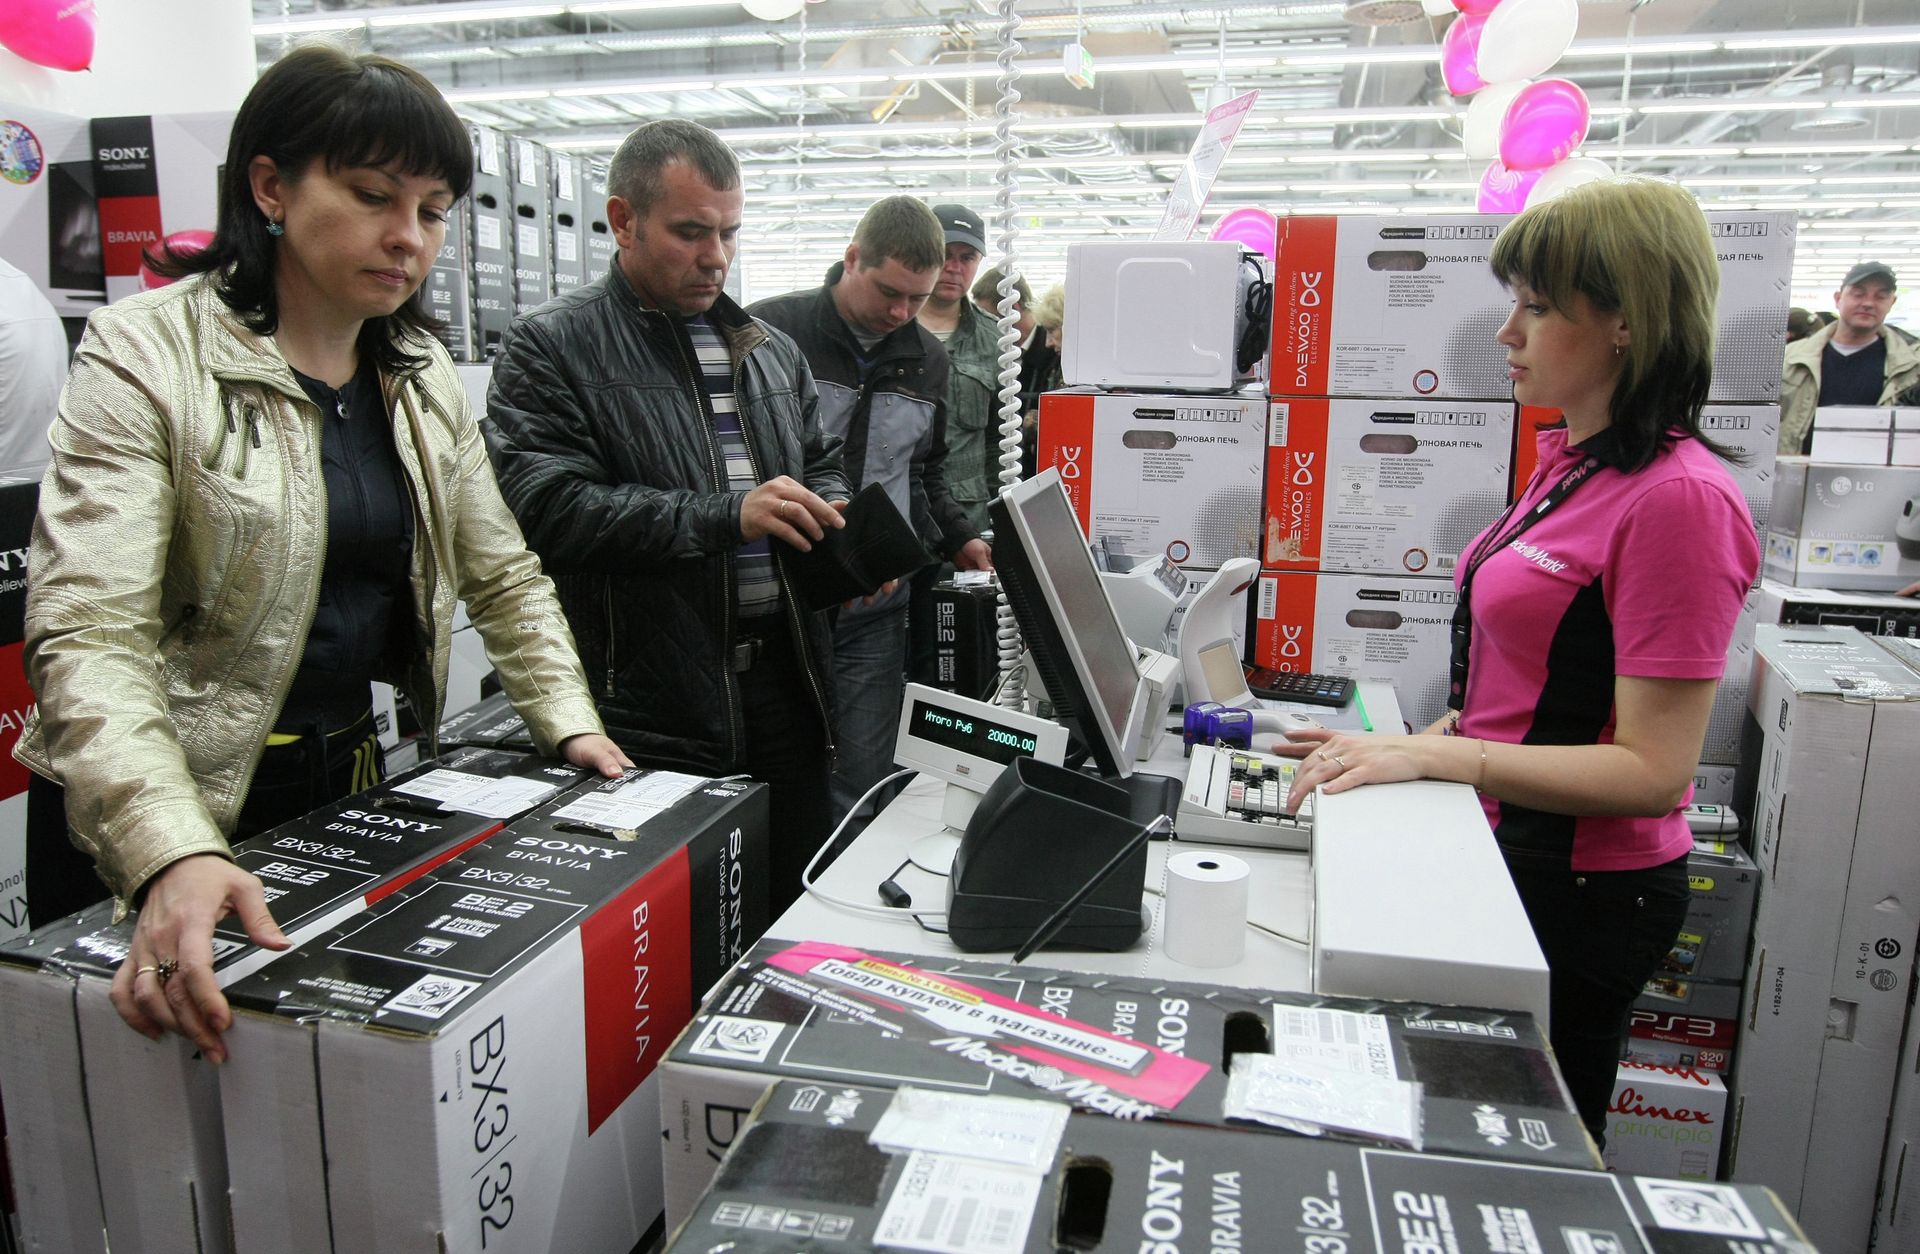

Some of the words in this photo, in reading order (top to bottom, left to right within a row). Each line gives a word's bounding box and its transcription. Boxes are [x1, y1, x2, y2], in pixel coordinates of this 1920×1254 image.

[99, 146, 149, 161] SONY
[107, 230, 157, 243] BRAVIA
[589, 238, 612, 250] SONY
[475, 262, 504, 275] SONY
[1738, 253, 1764, 262] ПЕЧЬ
[516, 268, 542, 281] SONY
[555, 273, 578, 285] SONY
[1286, 308, 1297, 353] Designing
[1310, 312, 1319, 364] ELECTRONICS
[1296, 312, 1311, 387] DAEWOO
[1217, 436, 1239, 444] ПЕЧЬ
[1460, 440, 1482, 448] ПЕЧЬ
[1724, 443, 1746, 454] ЕЧЬ
[1282, 450, 1290, 490] Excellence
[1856, 481, 1874, 492] LG
[1280, 490, 1290, 530] Designing
[1303, 491, 1312, 541] ELECTRONICS
[1809, 528, 1849, 539] Vacuum
[1851, 530, 1885, 540] Cleaner
[1530, 550, 1569, 573] Markt
[925, 710, 952, 727] Итого
[956, 719, 973, 734] Руб
[988, 728, 1035, 752] 20000.00
[325, 822, 403, 843] BRAVIA
[338, 810, 442, 833] SONY
[514, 836, 628, 860] SONY
[506, 850, 592, 872] BRAVIA
[728, 826, 743, 963] SONY
[451, 902, 484, 912] BRAVIA
[484, 906, 523, 920] ENGINE
[719, 847, 728, 967] make.believe
[454, 916, 501, 930] Intelligent
[864, 960, 904, 978] Цены
[632, 900, 651, 1064] BRAVIA
[820, 962, 884, 987] Товар
[886, 984, 967, 1014] куплен
[969, 1010, 982, 1018] в
[1772, 966, 1786, 1016] 4-182-957-04
[1112, 1000, 1138, 1040] BRA
[1630, 1010, 1716, 1037] PS3
[1700, 1050, 1724, 1063] 320
[930, 1036, 1034, 1080] Media
[1050, 1077, 1155, 1121] Markt
[1614, 1120, 1712, 1147] principio
